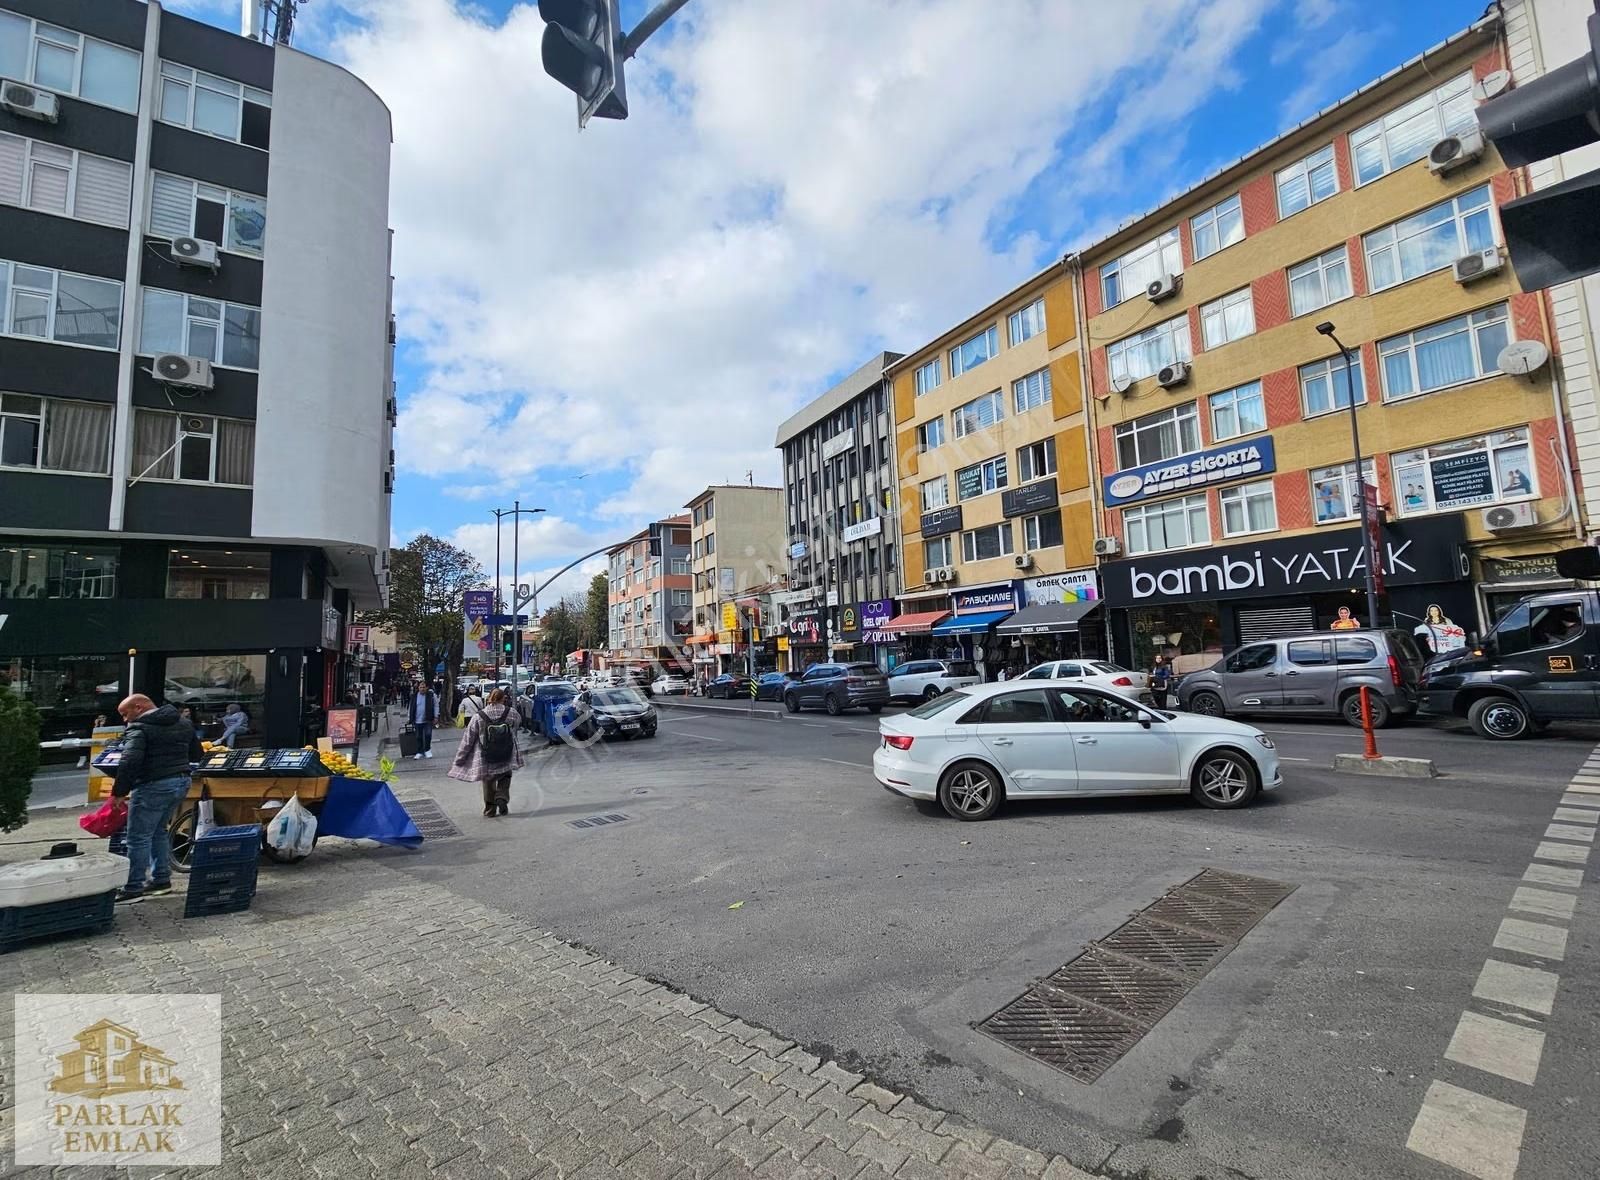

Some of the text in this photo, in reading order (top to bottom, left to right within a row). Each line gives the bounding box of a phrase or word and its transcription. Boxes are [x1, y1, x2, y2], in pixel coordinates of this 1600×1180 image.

[1143, 446, 1261, 485] AYZER SİGORTA
[1036, 574, 1087, 588] ÖRNEK ÇANTA
[1130, 551, 1265, 599] bambi
[965, 592, 1011, 606] PABUÇHANE
[354, 628, 365, 639] E
